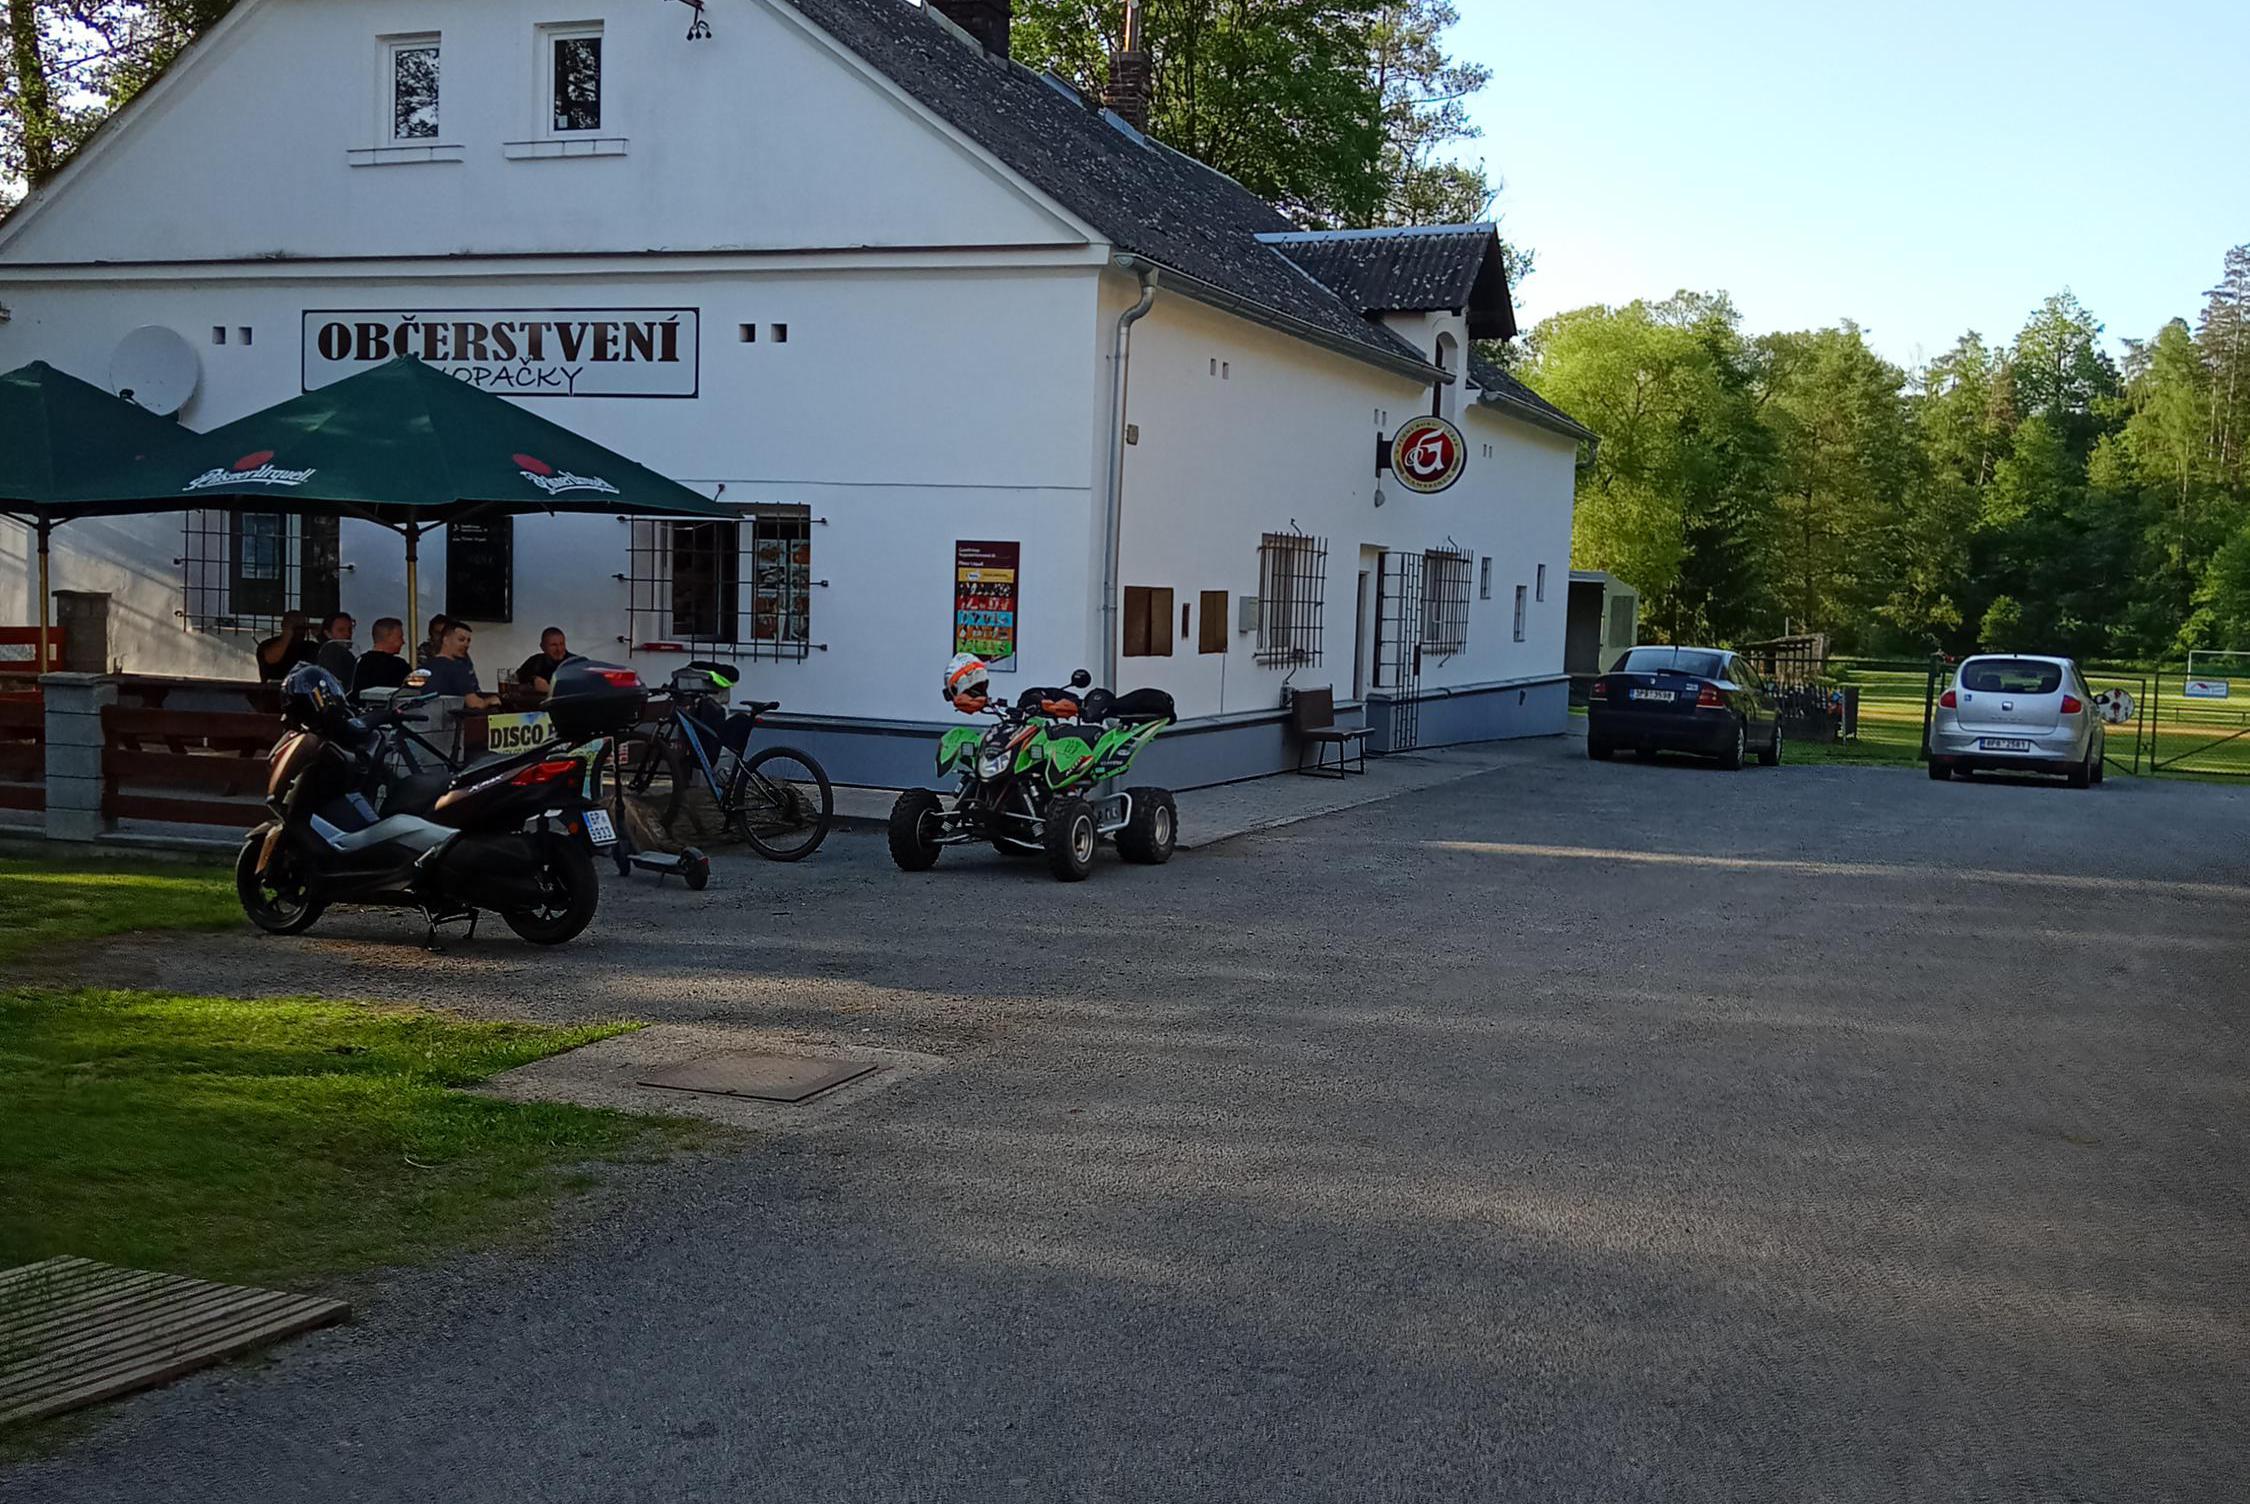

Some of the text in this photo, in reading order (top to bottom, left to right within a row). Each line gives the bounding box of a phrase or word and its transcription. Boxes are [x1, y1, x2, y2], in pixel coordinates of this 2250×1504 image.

[317, 314, 681, 362] OBČERSTVENÍ
[442, 355, 584, 396] OPAČKY
[490, 724, 544, 748] DISCO
